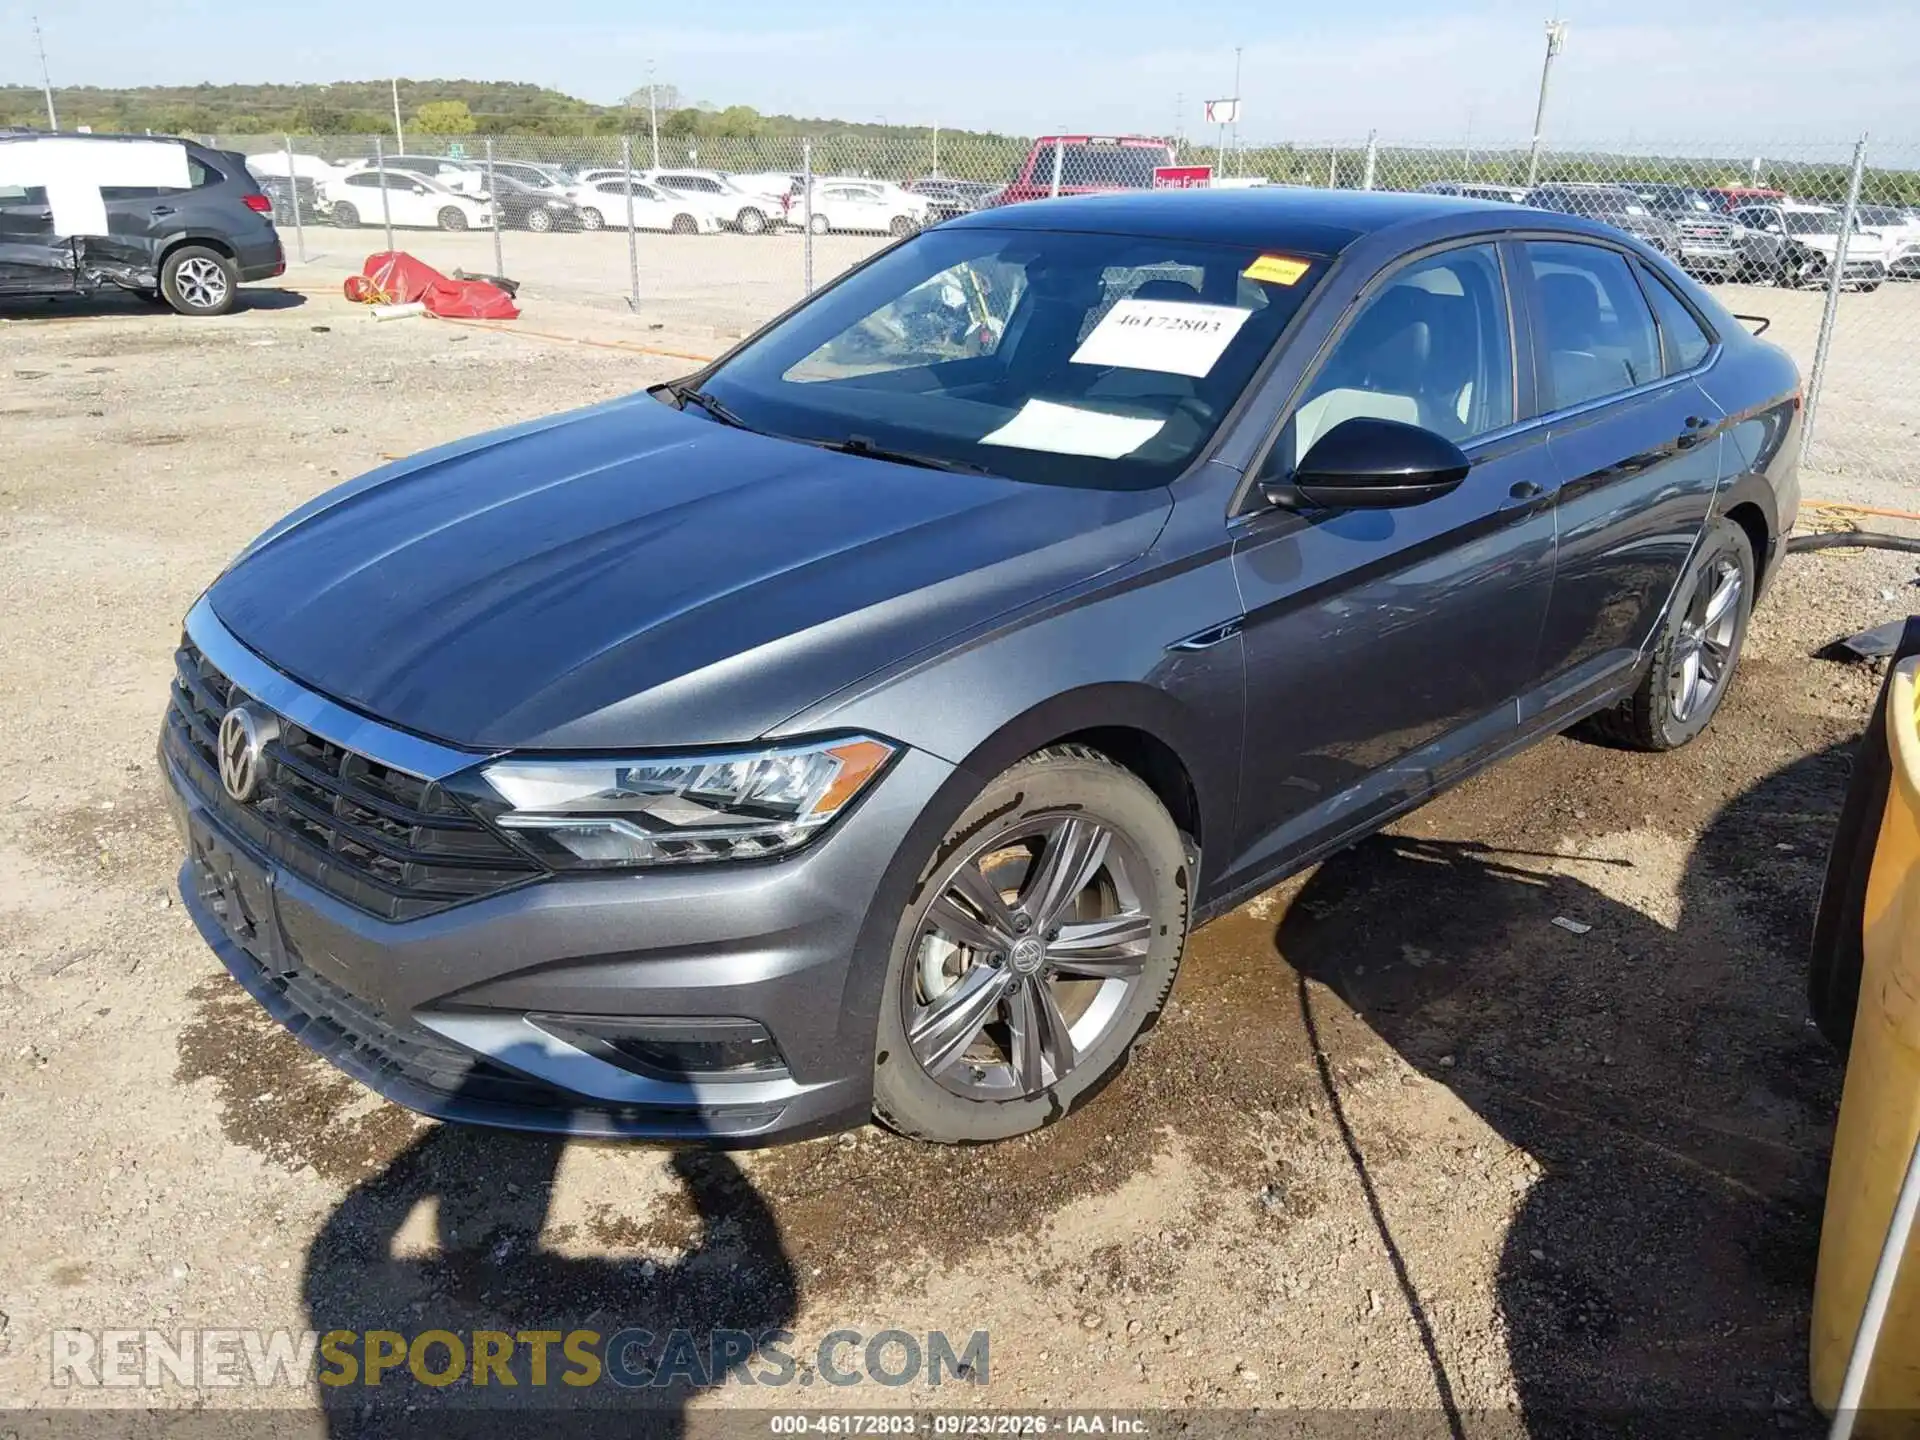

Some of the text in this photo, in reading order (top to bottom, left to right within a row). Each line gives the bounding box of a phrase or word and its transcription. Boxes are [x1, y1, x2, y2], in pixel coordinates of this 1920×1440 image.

[1156, 175, 1210, 189] State Farm
[1115, 314, 1221, 333] 46172803
